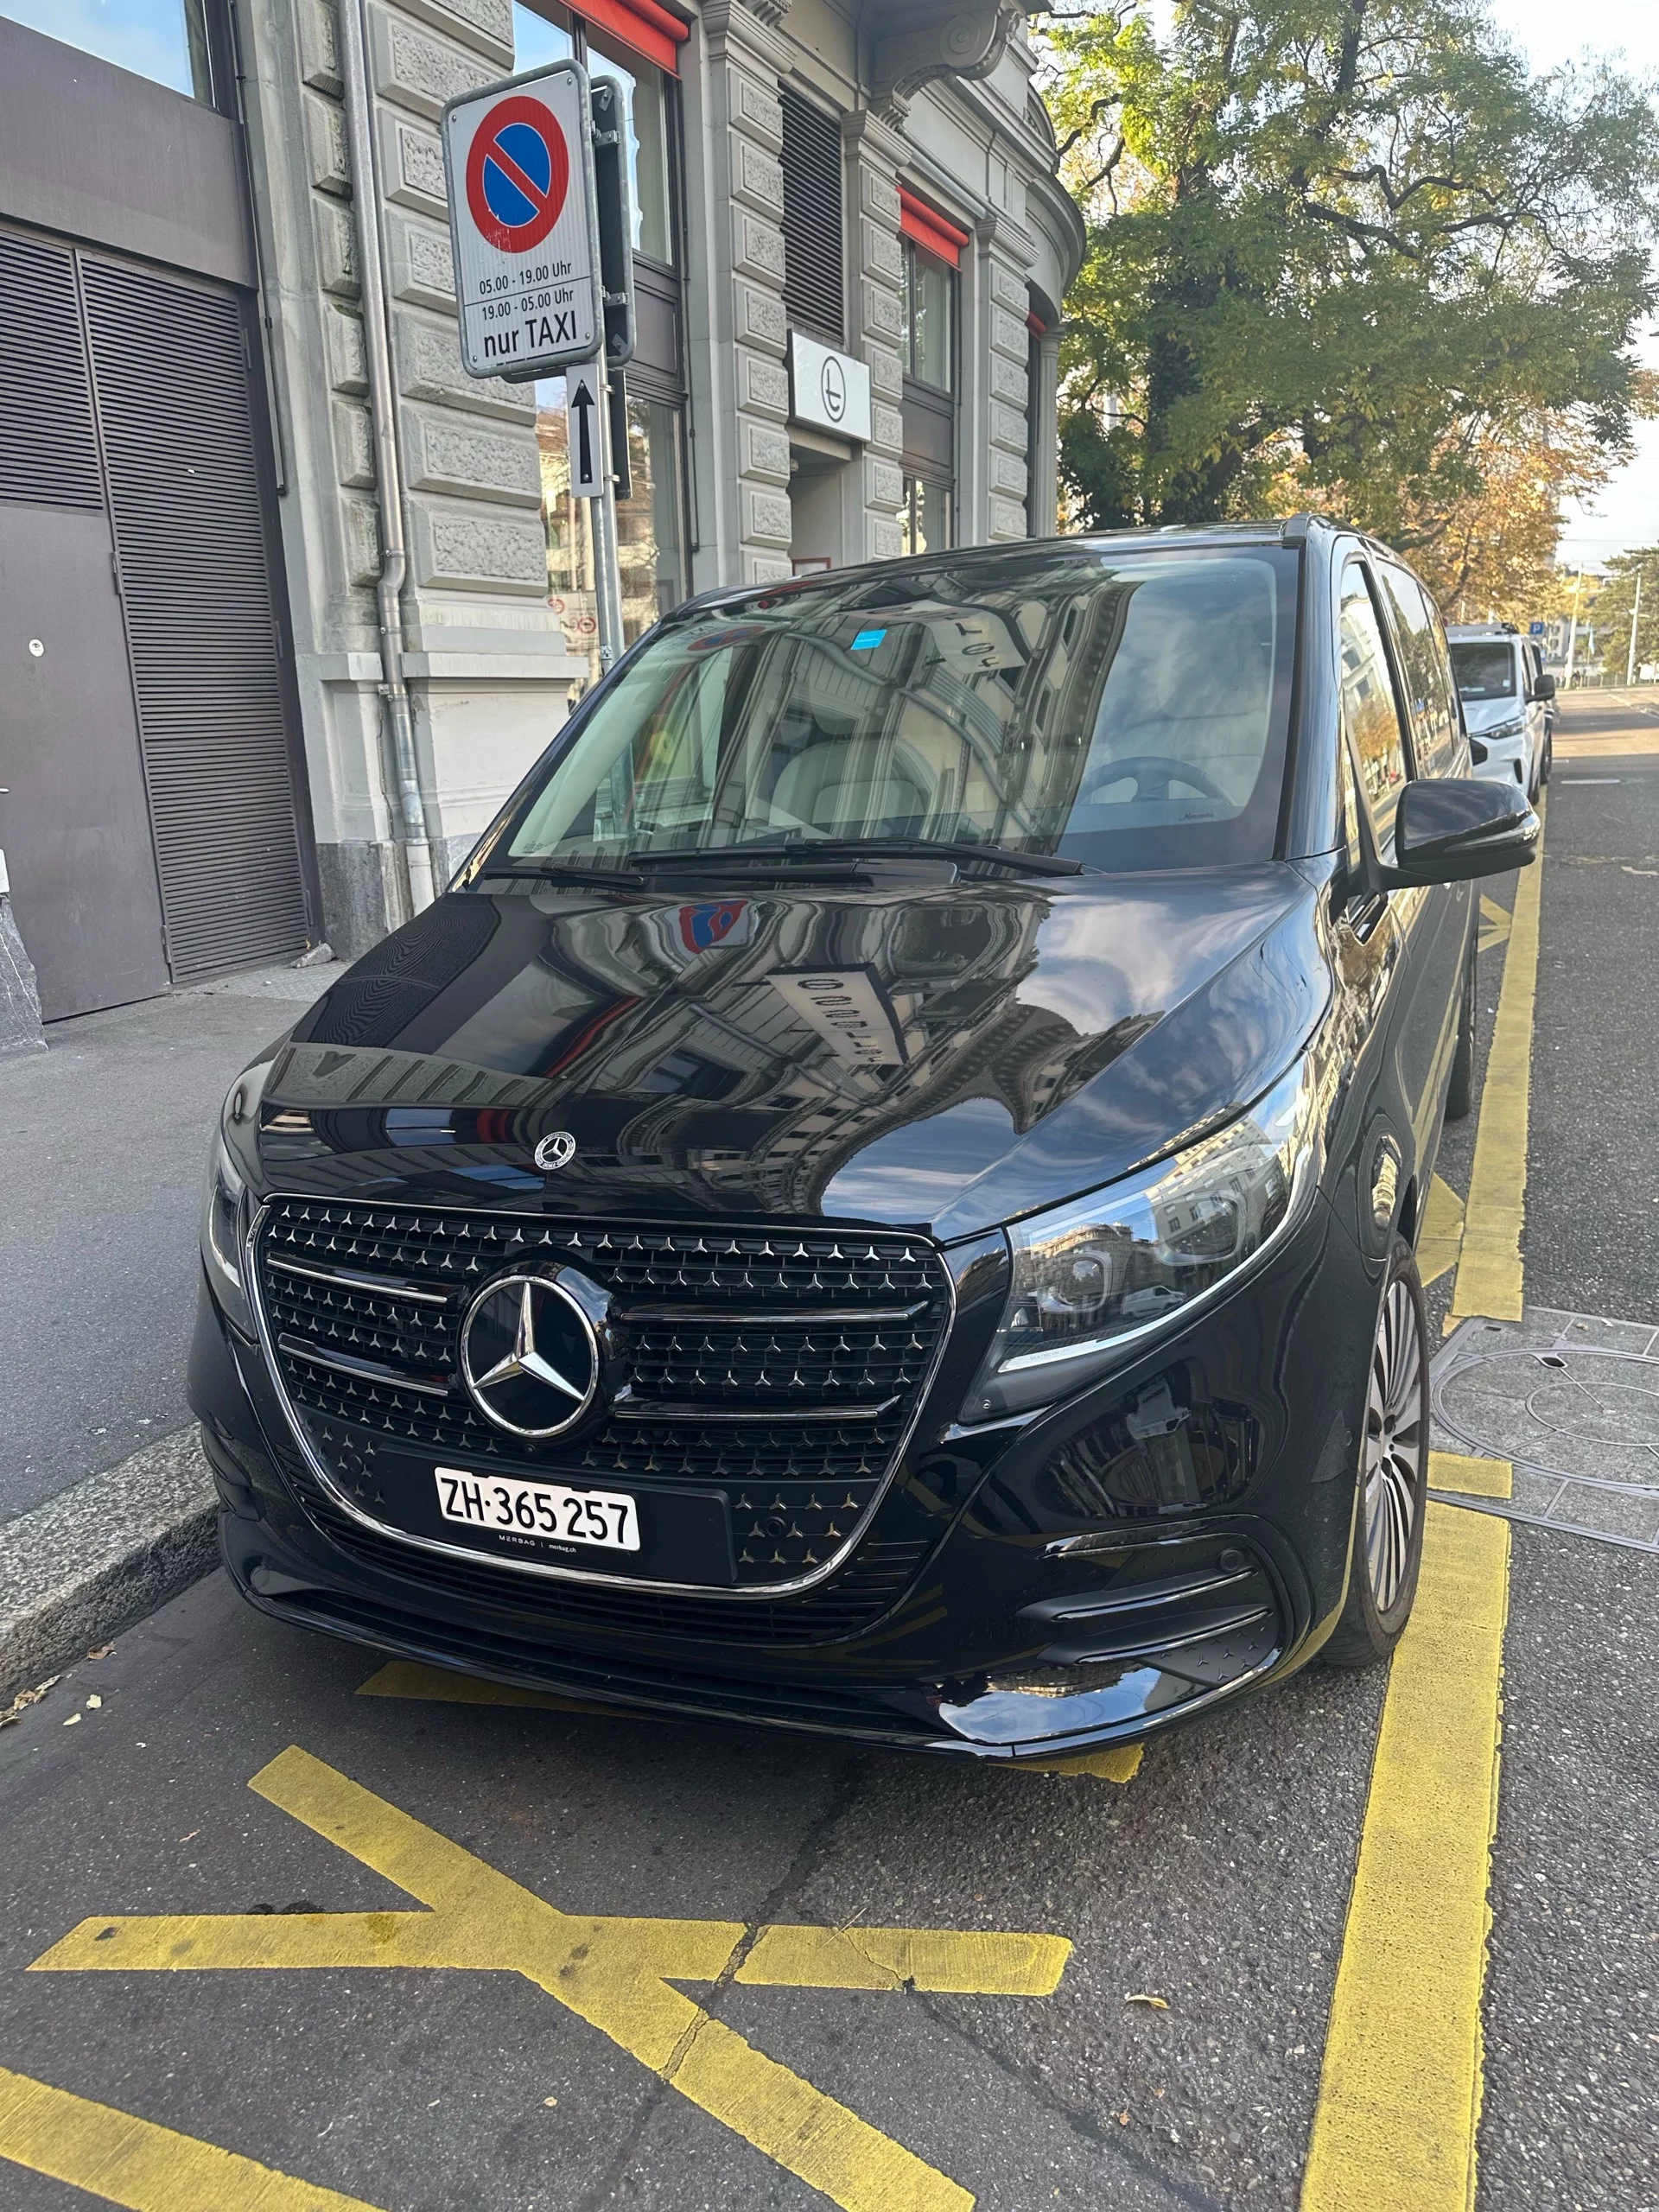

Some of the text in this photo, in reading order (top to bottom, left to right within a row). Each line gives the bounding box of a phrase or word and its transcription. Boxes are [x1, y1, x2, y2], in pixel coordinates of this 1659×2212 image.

[480, 275, 509, 295] 05.00
[519, 265, 549, 285] 19.00
[552, 260, 571, 276] Uhr
[482, 302, 511, 321] 19.00
[521, 292, 551, 312] 05.00
[554, 288, 574, 304] Uhr
[484, 310, 577, 358] nur TAXI
[499, 1535, 536, 1547] MERBAG
[549, 1543, 576, 1553] merbag.ch
